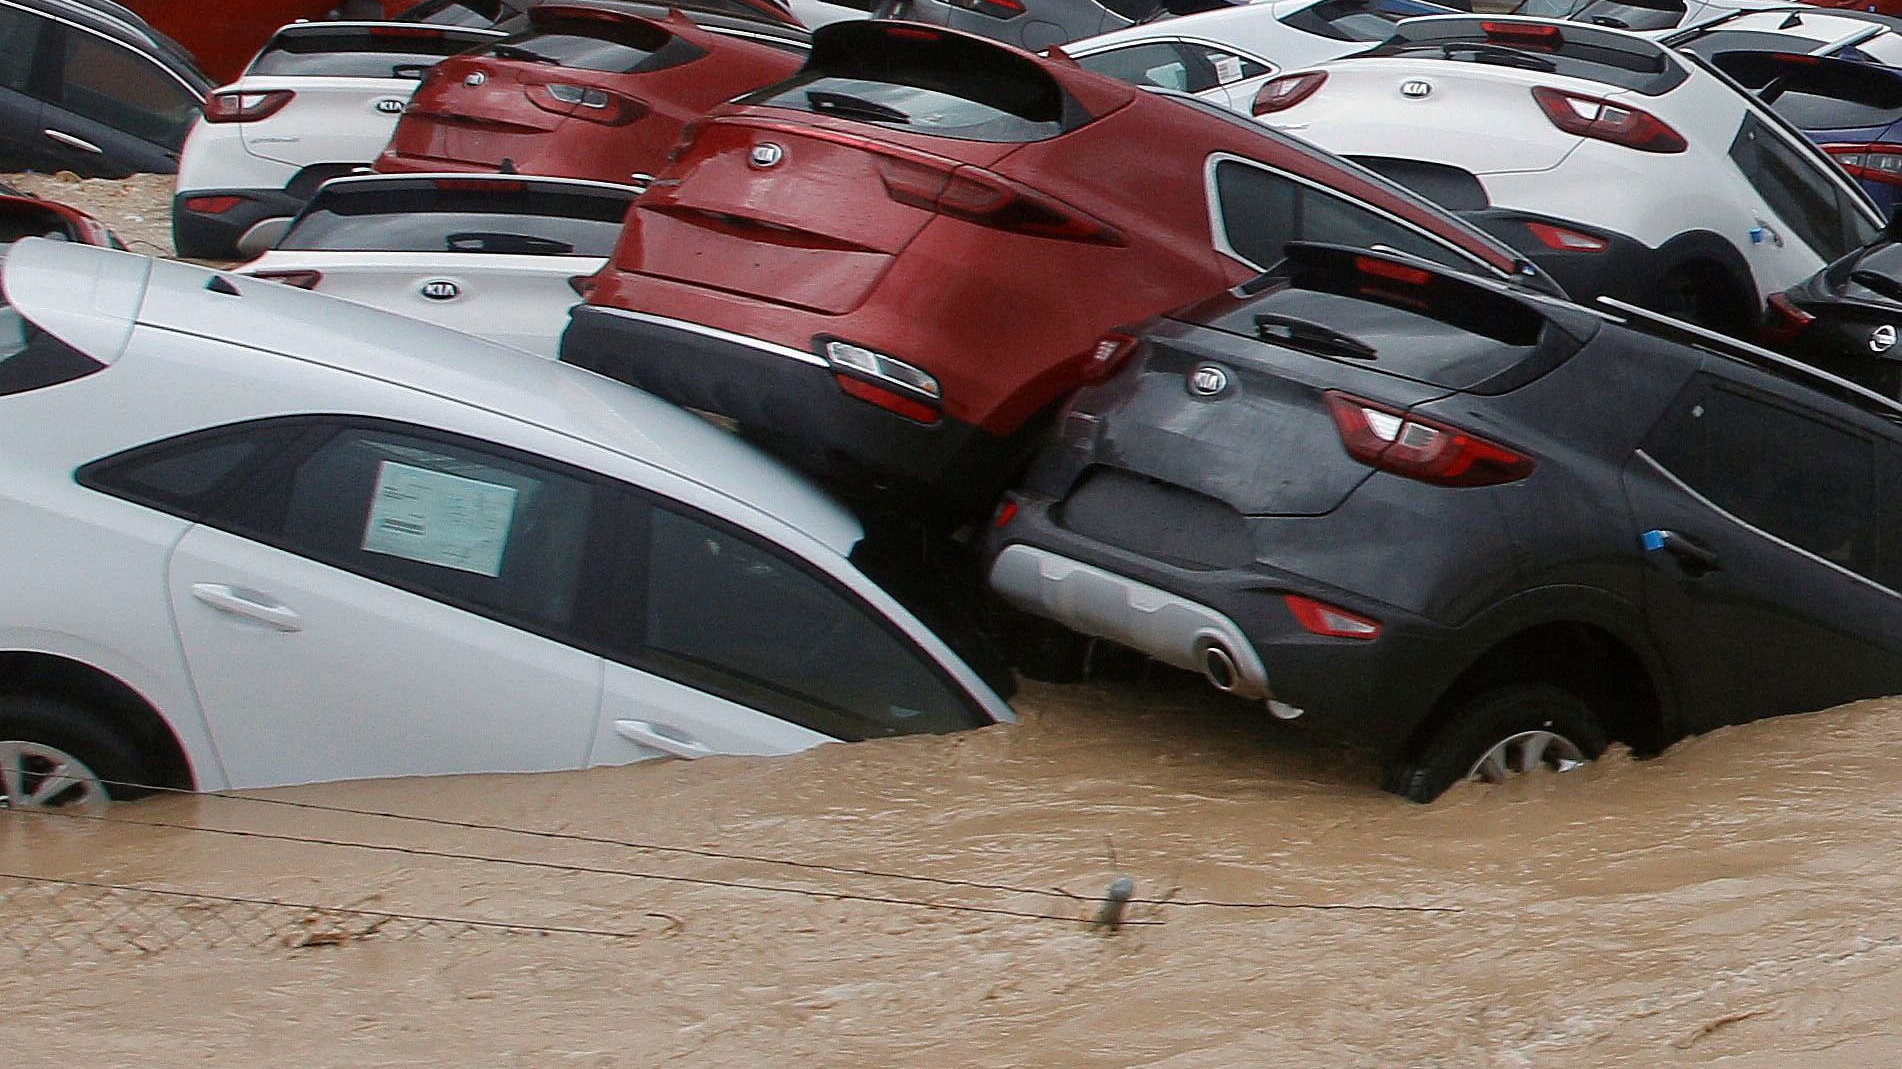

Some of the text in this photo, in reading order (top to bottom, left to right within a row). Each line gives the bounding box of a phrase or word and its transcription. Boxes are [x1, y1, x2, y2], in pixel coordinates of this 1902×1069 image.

[1402, 82, 1428, 94] KIA
[379, 101, 402, 111] KIA
[425, 283, 455, 296] KIA
